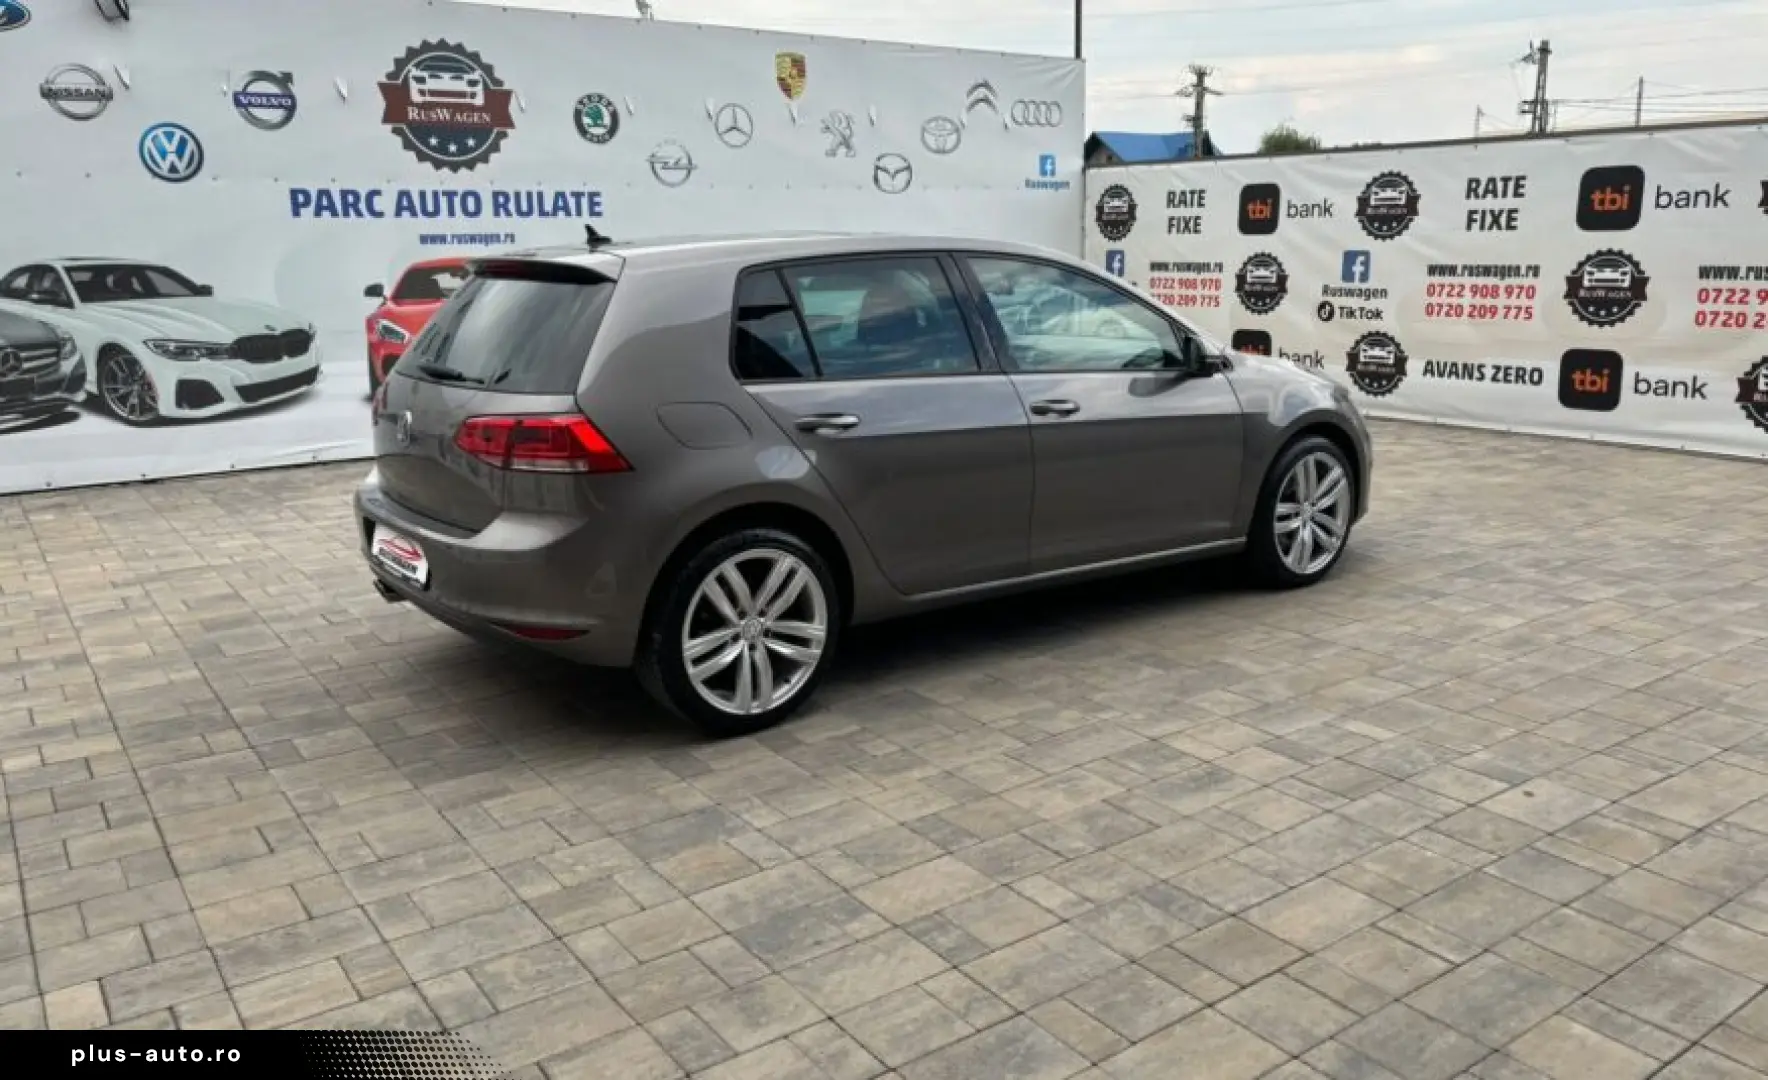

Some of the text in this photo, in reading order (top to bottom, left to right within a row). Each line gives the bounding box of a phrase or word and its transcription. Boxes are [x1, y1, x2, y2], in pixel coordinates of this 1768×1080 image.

[48, 87, 106, 98] NISSAN
[239, 95, 292, 106] VOLVO
[1465, 175, 1527, 200] RATE
[289, 187, 604, 218] PARC AUTO RULATE
[1166, 189, 1207, 209] RATE
[1590, 183, 1732, 211] tbi bank
[1247, 197, 1333, 220] tbi bank
[1167, 215, 1202, 235] FIXE
[1466, 208, 1519, 232] FIXE
[1427, 264, 1540, 281] www.ruswagen.ro
[1150, 277, 1222, 291] 0722 908 970
[1322, 284, 1388, 300] Ruswagen
[1426, 284, 1536, 300] 0722 908 970
[1200, 295, 1220, 307] 775
[1697, 287, 1751, 305] 0722
[1337, 305, 1384, 321] TikTok
[1425, 303, 1534, 320] 0720 209 775
[1695, 310, 1748, 328] 0720
[1423, 359, 1544, 386] AVANS ZERO
[1571, 368, 1708, 400] tbi bank
